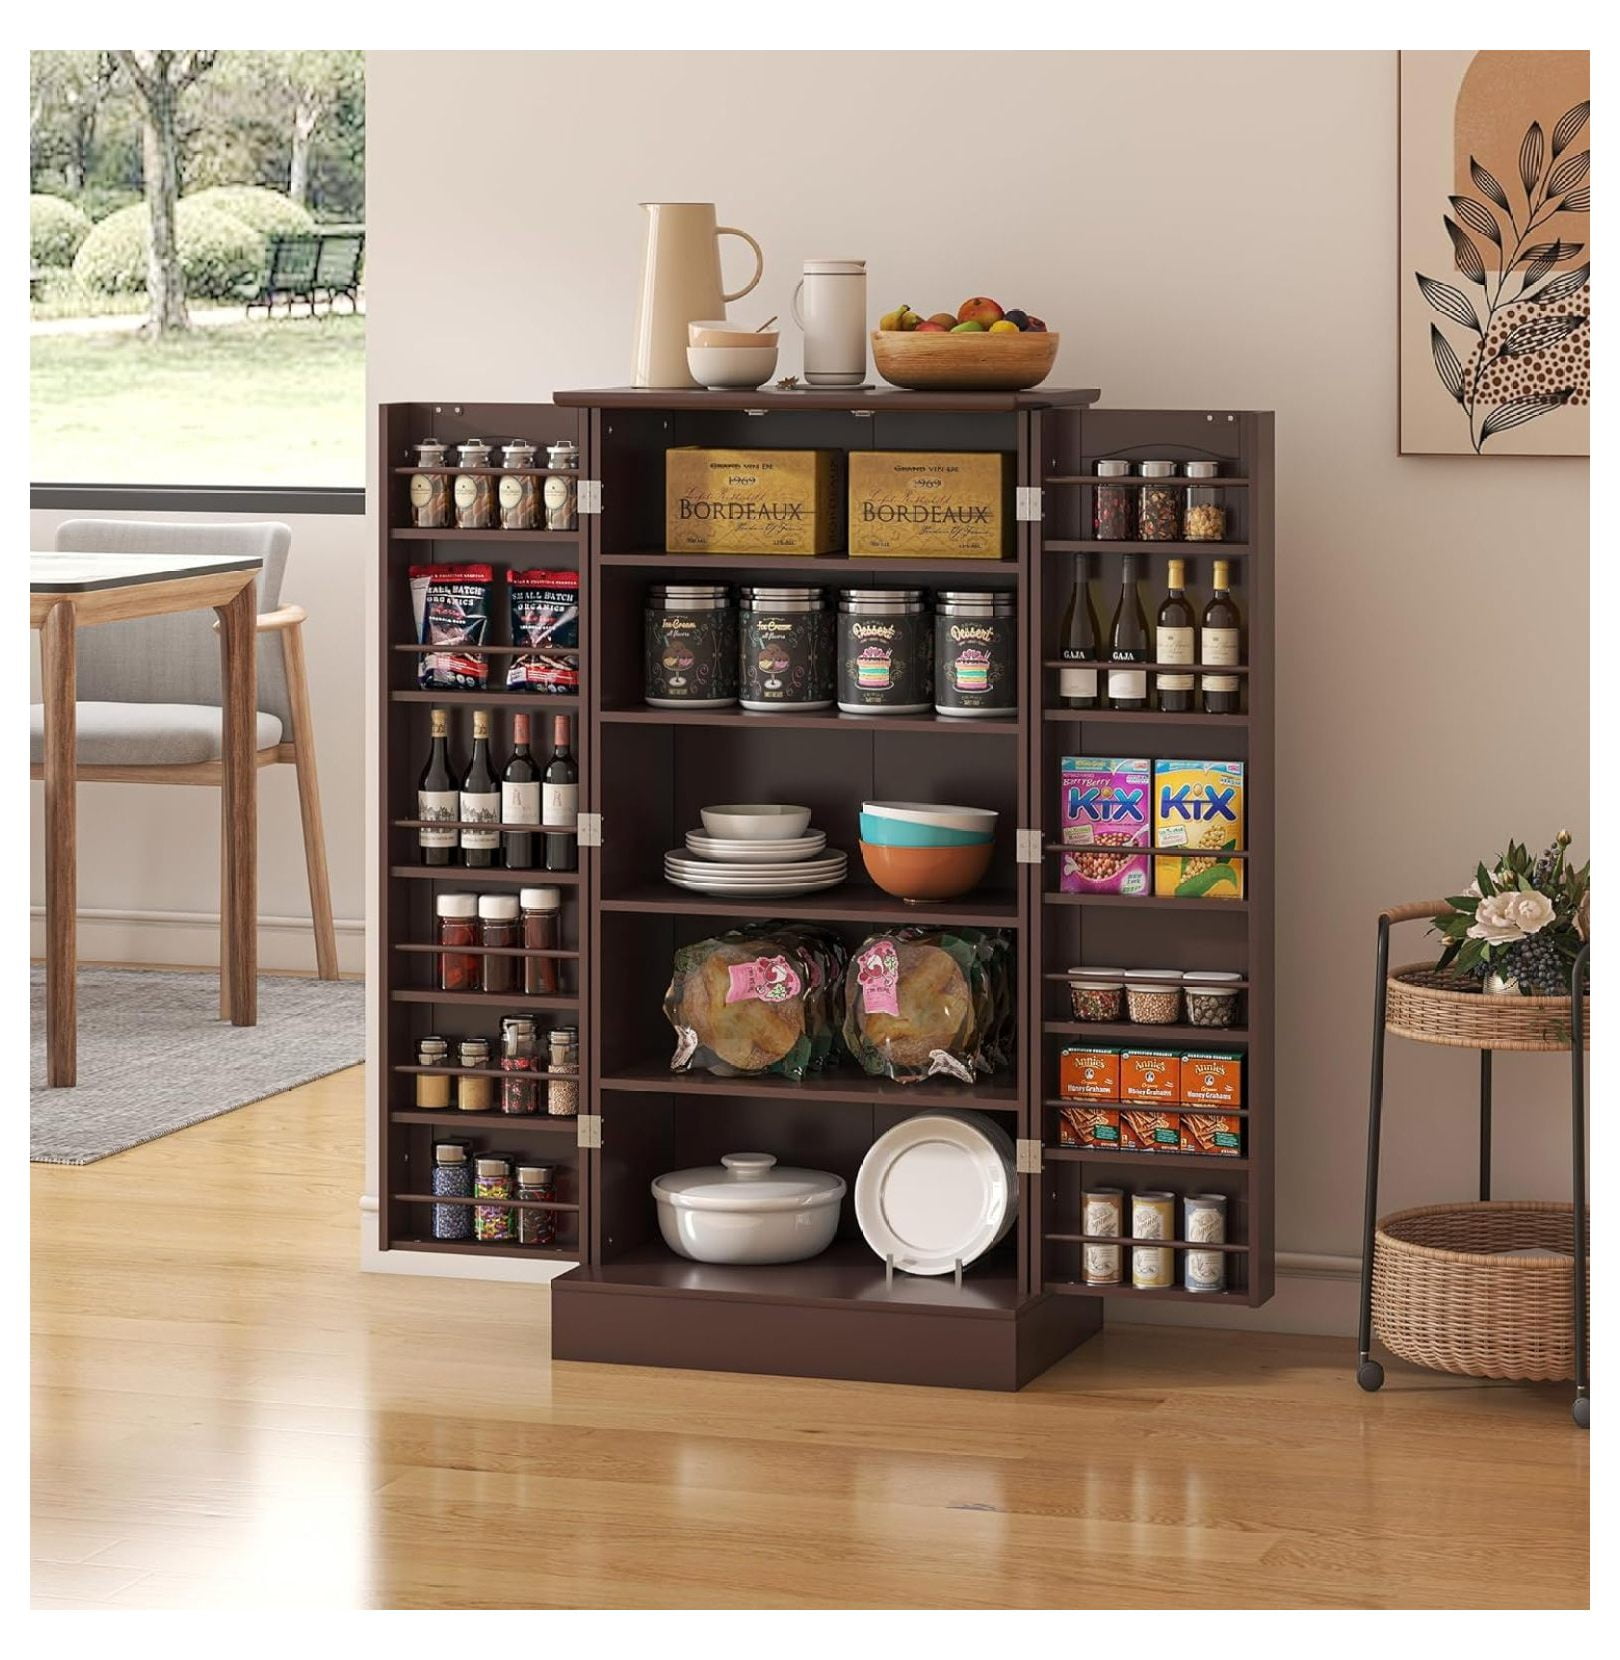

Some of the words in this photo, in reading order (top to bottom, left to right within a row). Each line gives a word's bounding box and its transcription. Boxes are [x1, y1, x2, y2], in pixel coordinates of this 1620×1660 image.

[680, 499, 802, 520] BORDEAUX
[863, 501, 988, 523] BORDEAUX
[1064, 651, 1085, 659] GAJA
[1113, 652, 1134, 660] GAJA
